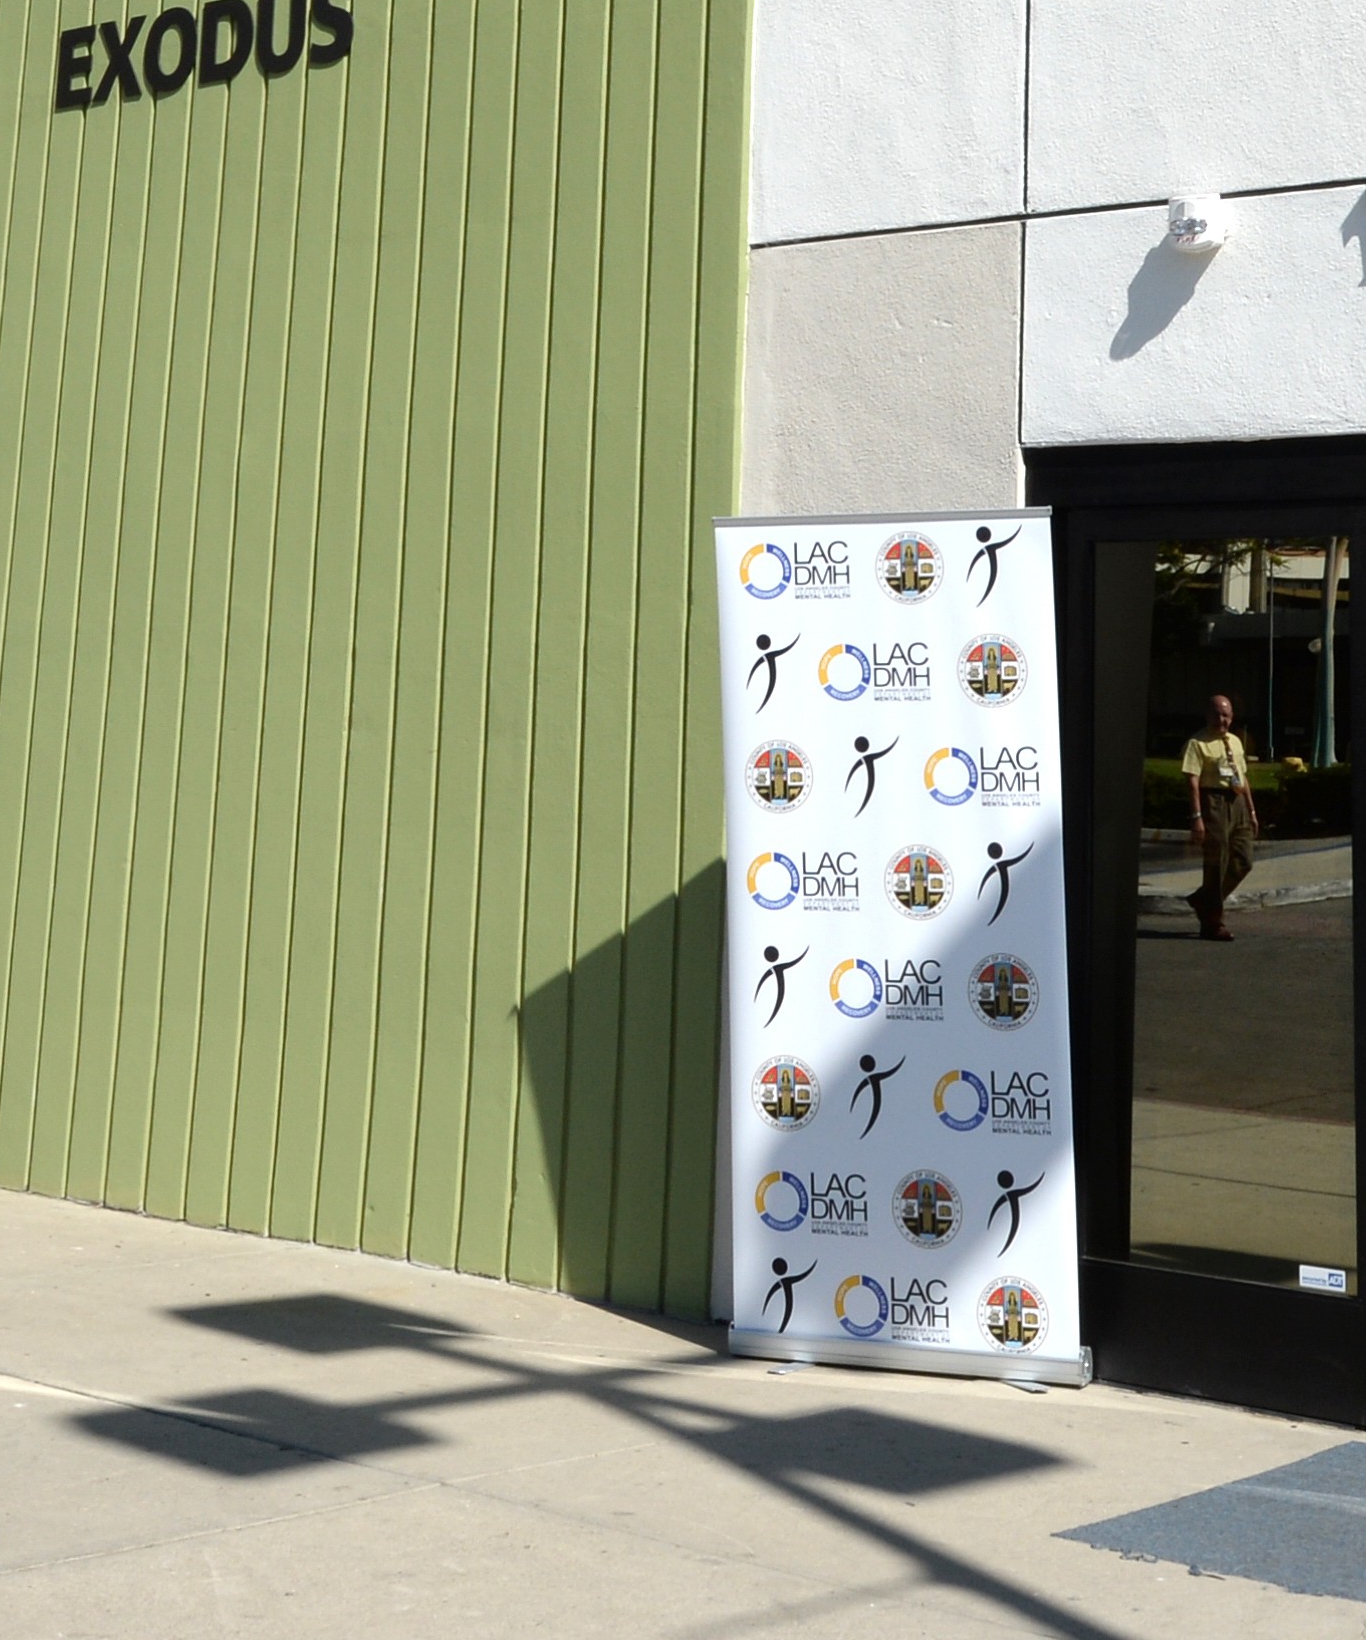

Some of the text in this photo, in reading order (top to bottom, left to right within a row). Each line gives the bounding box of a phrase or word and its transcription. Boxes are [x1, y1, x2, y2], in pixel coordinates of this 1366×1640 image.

[794, 541, 848, 564] LAC
[795, 565, 850, 585] DMH
[873, 642, 929, 666] LAC
[874, 667, 930, 687] DMH
[980, 746, 1038, 770] LAC
[981, 772, 1039, 792] DMH
[802, 852, 857, 876] LAC
[803, 877, 859, 897] DMH
[885, 960, 941, 984] LAC
[886, 984, 943, 1006] DMH
[991, 1071, 1049, 1097] LAC
[992, 1097, 1050, 1120] DMH
[811, 1172, 866, 1199] LAC
[811, 1198, 868, 1222] DMH
[891, 1277, 948, 1305] LAC
[892, 1303, 949, 1328] DMH
